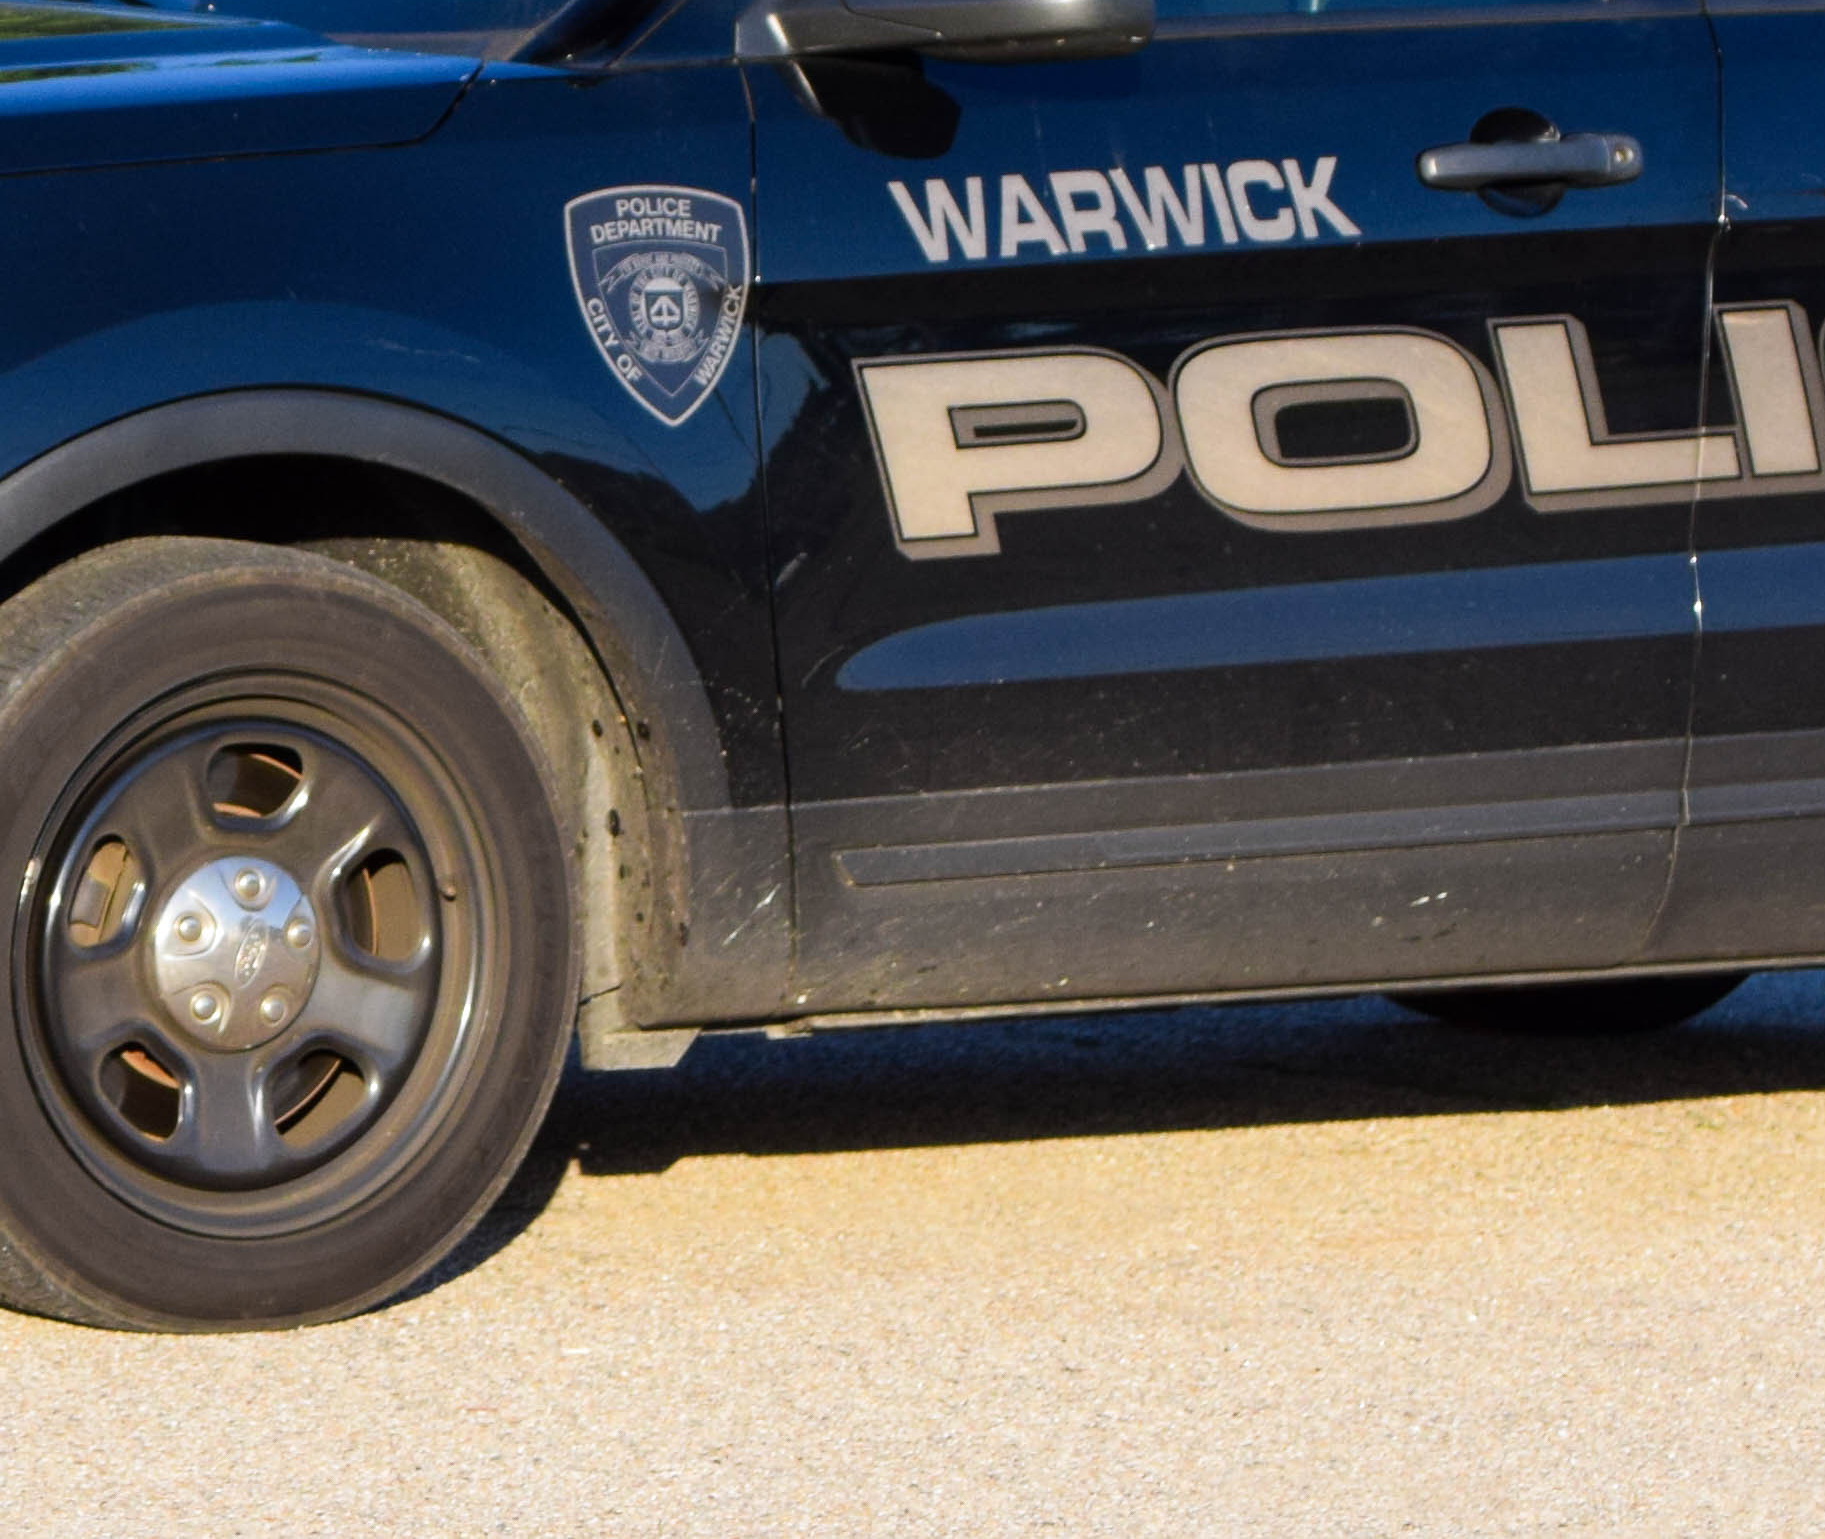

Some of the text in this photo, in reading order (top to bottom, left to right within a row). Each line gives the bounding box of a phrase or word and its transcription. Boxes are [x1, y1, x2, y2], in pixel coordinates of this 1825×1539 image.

[590, 218, 722, 245] DEPARTMENT
[615, 197, 692, 218] POLICE
[888, 156, 1361, 261] WARWICK
[587, 297, 643, 383] CITY OF
[693, 284, 743, 386] WARWICK
